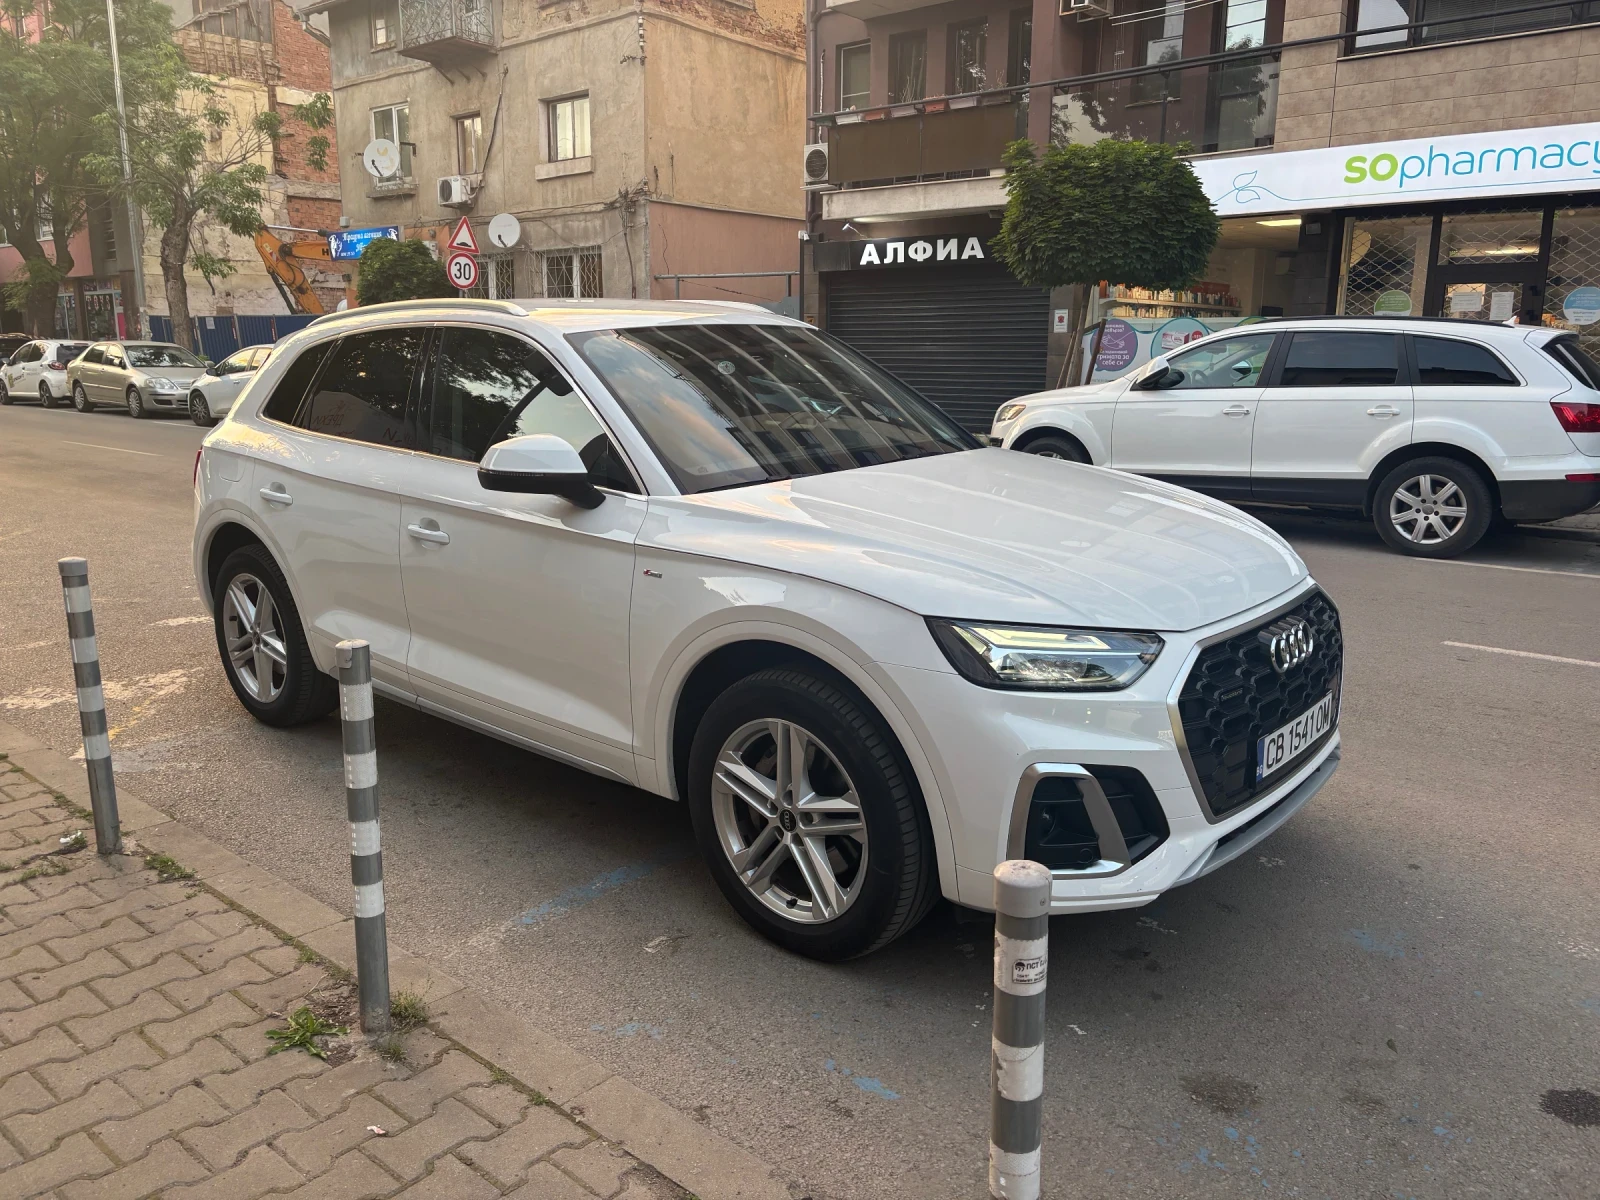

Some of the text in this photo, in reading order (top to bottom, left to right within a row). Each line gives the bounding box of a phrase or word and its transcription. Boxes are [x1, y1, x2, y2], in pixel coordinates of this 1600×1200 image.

[860, 237, 985, 265] АЛФИА
[454, 261, 471, 280] 30
[1267, 732, 1284, 769] CB
[1289, 710, 1314, 755] 1541
[1316, 698, 1331, 733] OM
